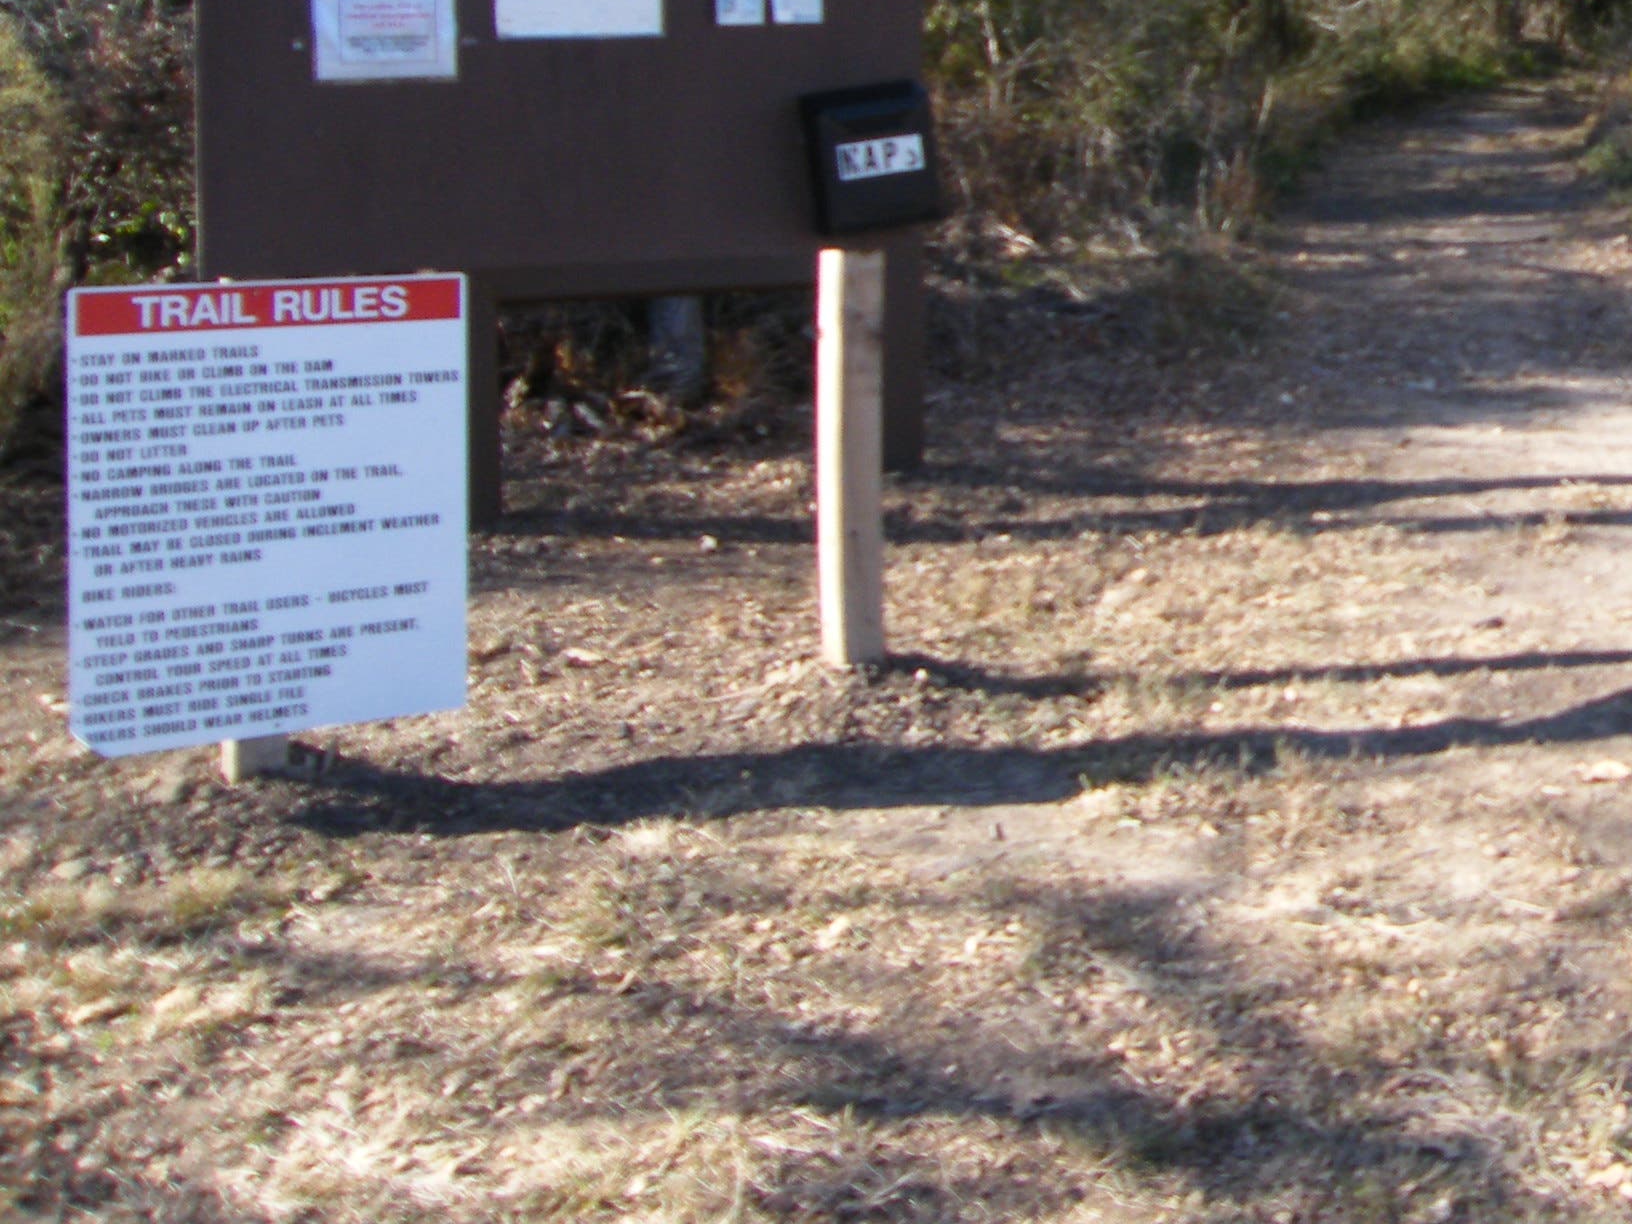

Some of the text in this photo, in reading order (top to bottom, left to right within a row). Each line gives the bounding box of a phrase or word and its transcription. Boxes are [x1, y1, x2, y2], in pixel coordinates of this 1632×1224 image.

[132, 285, 408, 328] TRAIL RULES
[80, 346, 259, 367] STAY ON MARKED TRAILS
[80, 360, 333, 386] DO NOT BIKE OR CLIMB ON THE DAM
[80, 370, 459, 405] DO NOT CLIMB THE ELECTRICAL TRANSMISSION TOWERS
[81, 391, 417, 425] ALL PETS MUST REMAIN ON LEASH AT ALL TIMES
[80, 414, 344, 444] OWNERS MUST CLEAN UP AFTER PETS
[80, 445, 187, 463] DO NOT LITTER
[81, 455, 296, 482] NO CAMPING ALONG THE TRAIL
[81, 486, 143, 501] NARROW
[150, 480, 208, 496] BRIDGES
[216, 478, 240, 490] ARE
[248, 472, 304, 488] LOCATED
[312, 471, 328, 482] ON
[334, 468, 357, 480] THE
[95, 489, 320, 520] APPROACH THESE WITH CAUTION
[81, 504, 355, 539] NO MOTORIZED VEHICLES ARE ALLOWED
[83, 514, 439, 558] TRAIL MAY BE CLOSED DURING INCLEMENT WEATHER
[94, 550, 262, 576] OR AFTER HEAVY RAINS
[83, 589, 114, 603] BIKE
[84, 582, 428, 630] WATCH FOR OTHER TRAIL USERS BICYCLES MUST
[83, 653, 127, 668] STEEP
[134, 646, 189, 662] GRADES
[196, 642, 223, 655] AND
[231, 636, 274, 651] SHARP
[282, 630, 323, 644] TURNS
[329, 627, 353, 639] ARE
[97, 619, 259, 648] YIELD TO PEDESTRIANS
[96, 645, 347, 686] CONTROL YOUR SPEED AT ALL TIMES
[84, 666, 330, 706] CHECK BRAKES PRIOR TO STARTING
[144, 702, 180, 717] MUST
[188, 698, 218, 712] RIDE
[226, 691, 270, 707] SINGLE
[279, 687, 304, 699] FILE
[144, 719, 196, 736] SHOULD
[204, 714, 242, 728] WEAR
[249, 704, 308, 721] HELMETS
